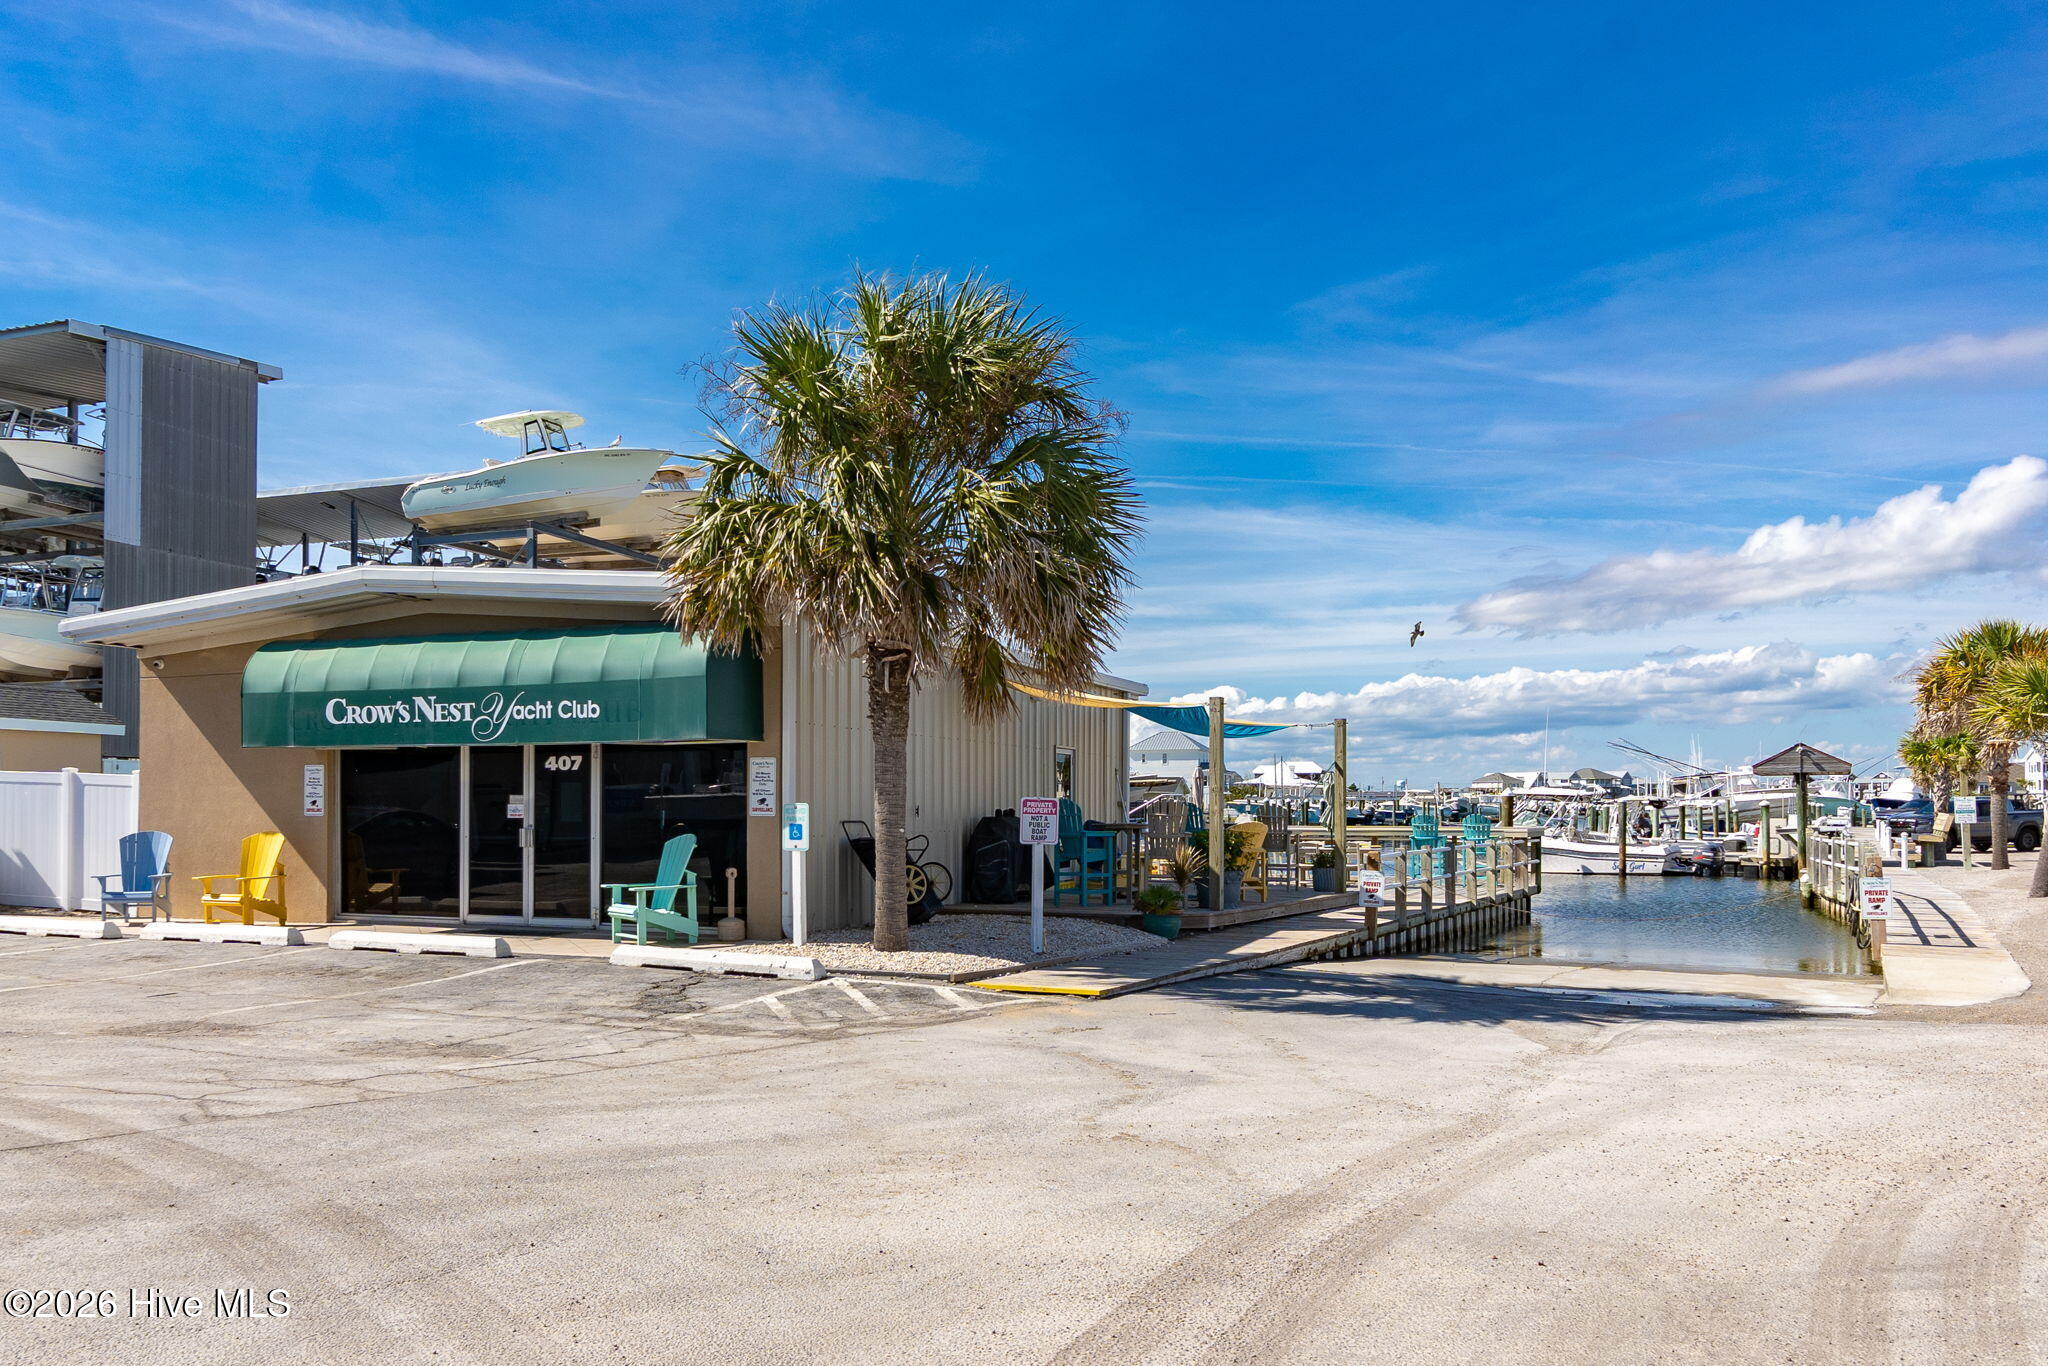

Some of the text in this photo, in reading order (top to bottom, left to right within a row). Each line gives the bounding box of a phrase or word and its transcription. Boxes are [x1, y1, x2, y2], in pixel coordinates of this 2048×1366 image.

[465, 479, 483, 491] Lucky
[325, 697, 410, 725] CROW'S
[412, 696, 475, 723] NEST
[471, 691, 552, 742] Yacht
[558, 699, 600, 719] Club
[545, 755, 583, 771] 407
